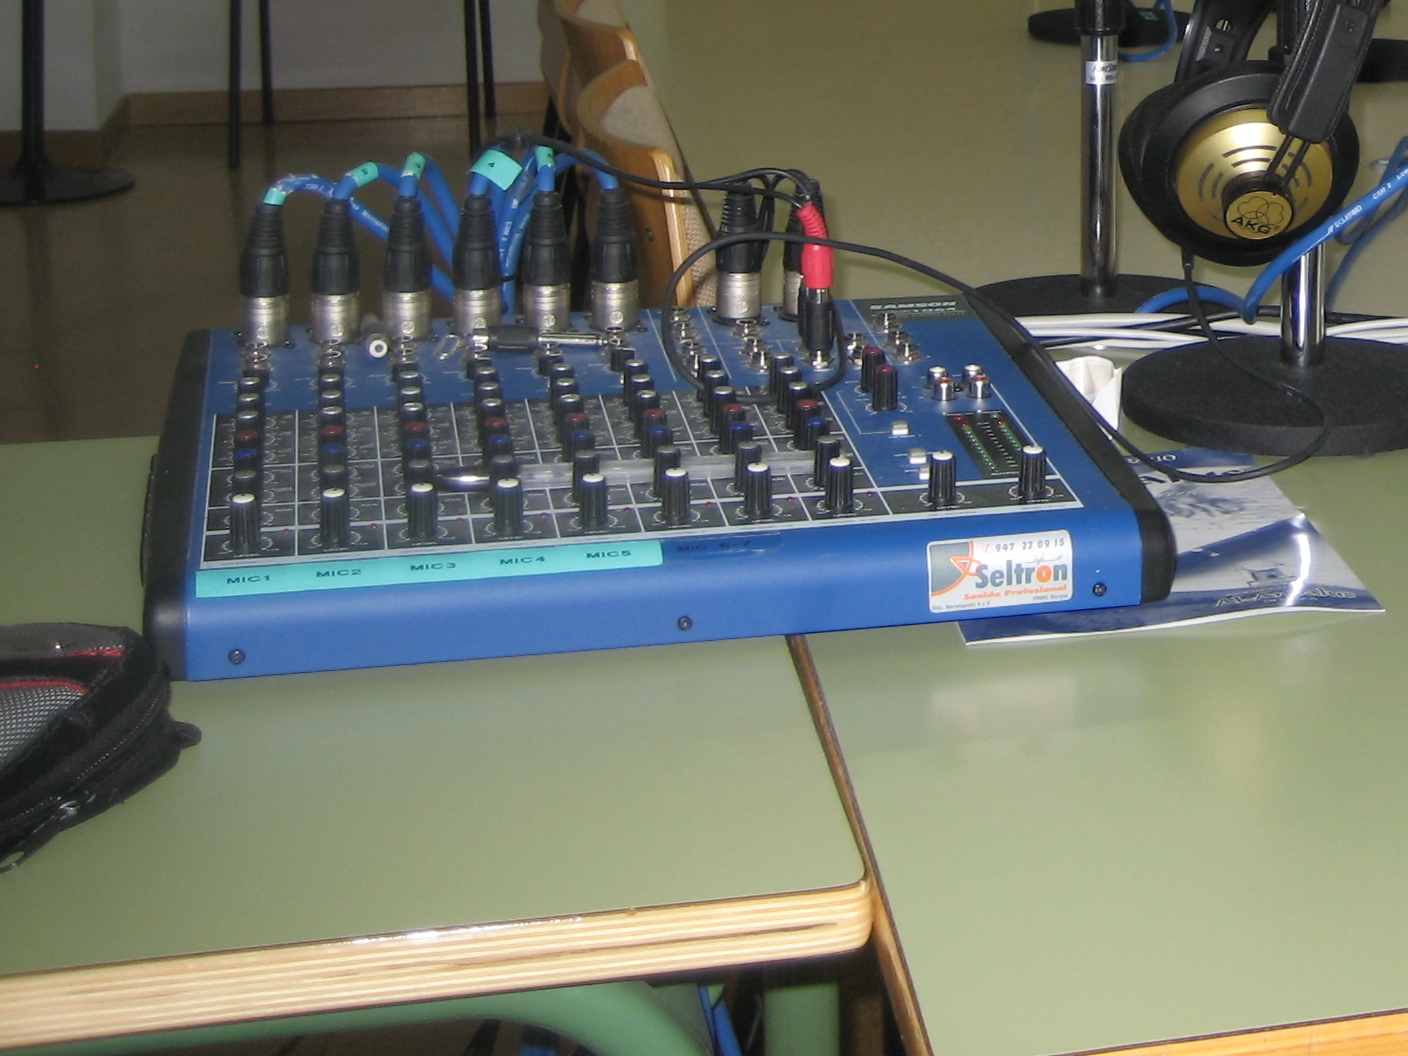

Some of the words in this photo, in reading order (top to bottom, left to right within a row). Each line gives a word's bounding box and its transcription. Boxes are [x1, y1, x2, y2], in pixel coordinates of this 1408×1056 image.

[1231, 217, 1271, 234] AKG
[869, 300, 957, 311] SAMSON
[677, 544, 708, 553] MIC
[995, 543, 1015, 553] 947
[1021, 541, 1033, 550] 22
[1037, 539, 1050, 549] 09
[1054, 538, 1065, 548] 15
[586, 549, 632, 560] MIC5
[315, 567, 362, 578] MIC2
[975, 559, 1068, 589] Seltron
[963, 590, 1002, 601] Sonido
[1004, 584, 1068, 597] Profesional
